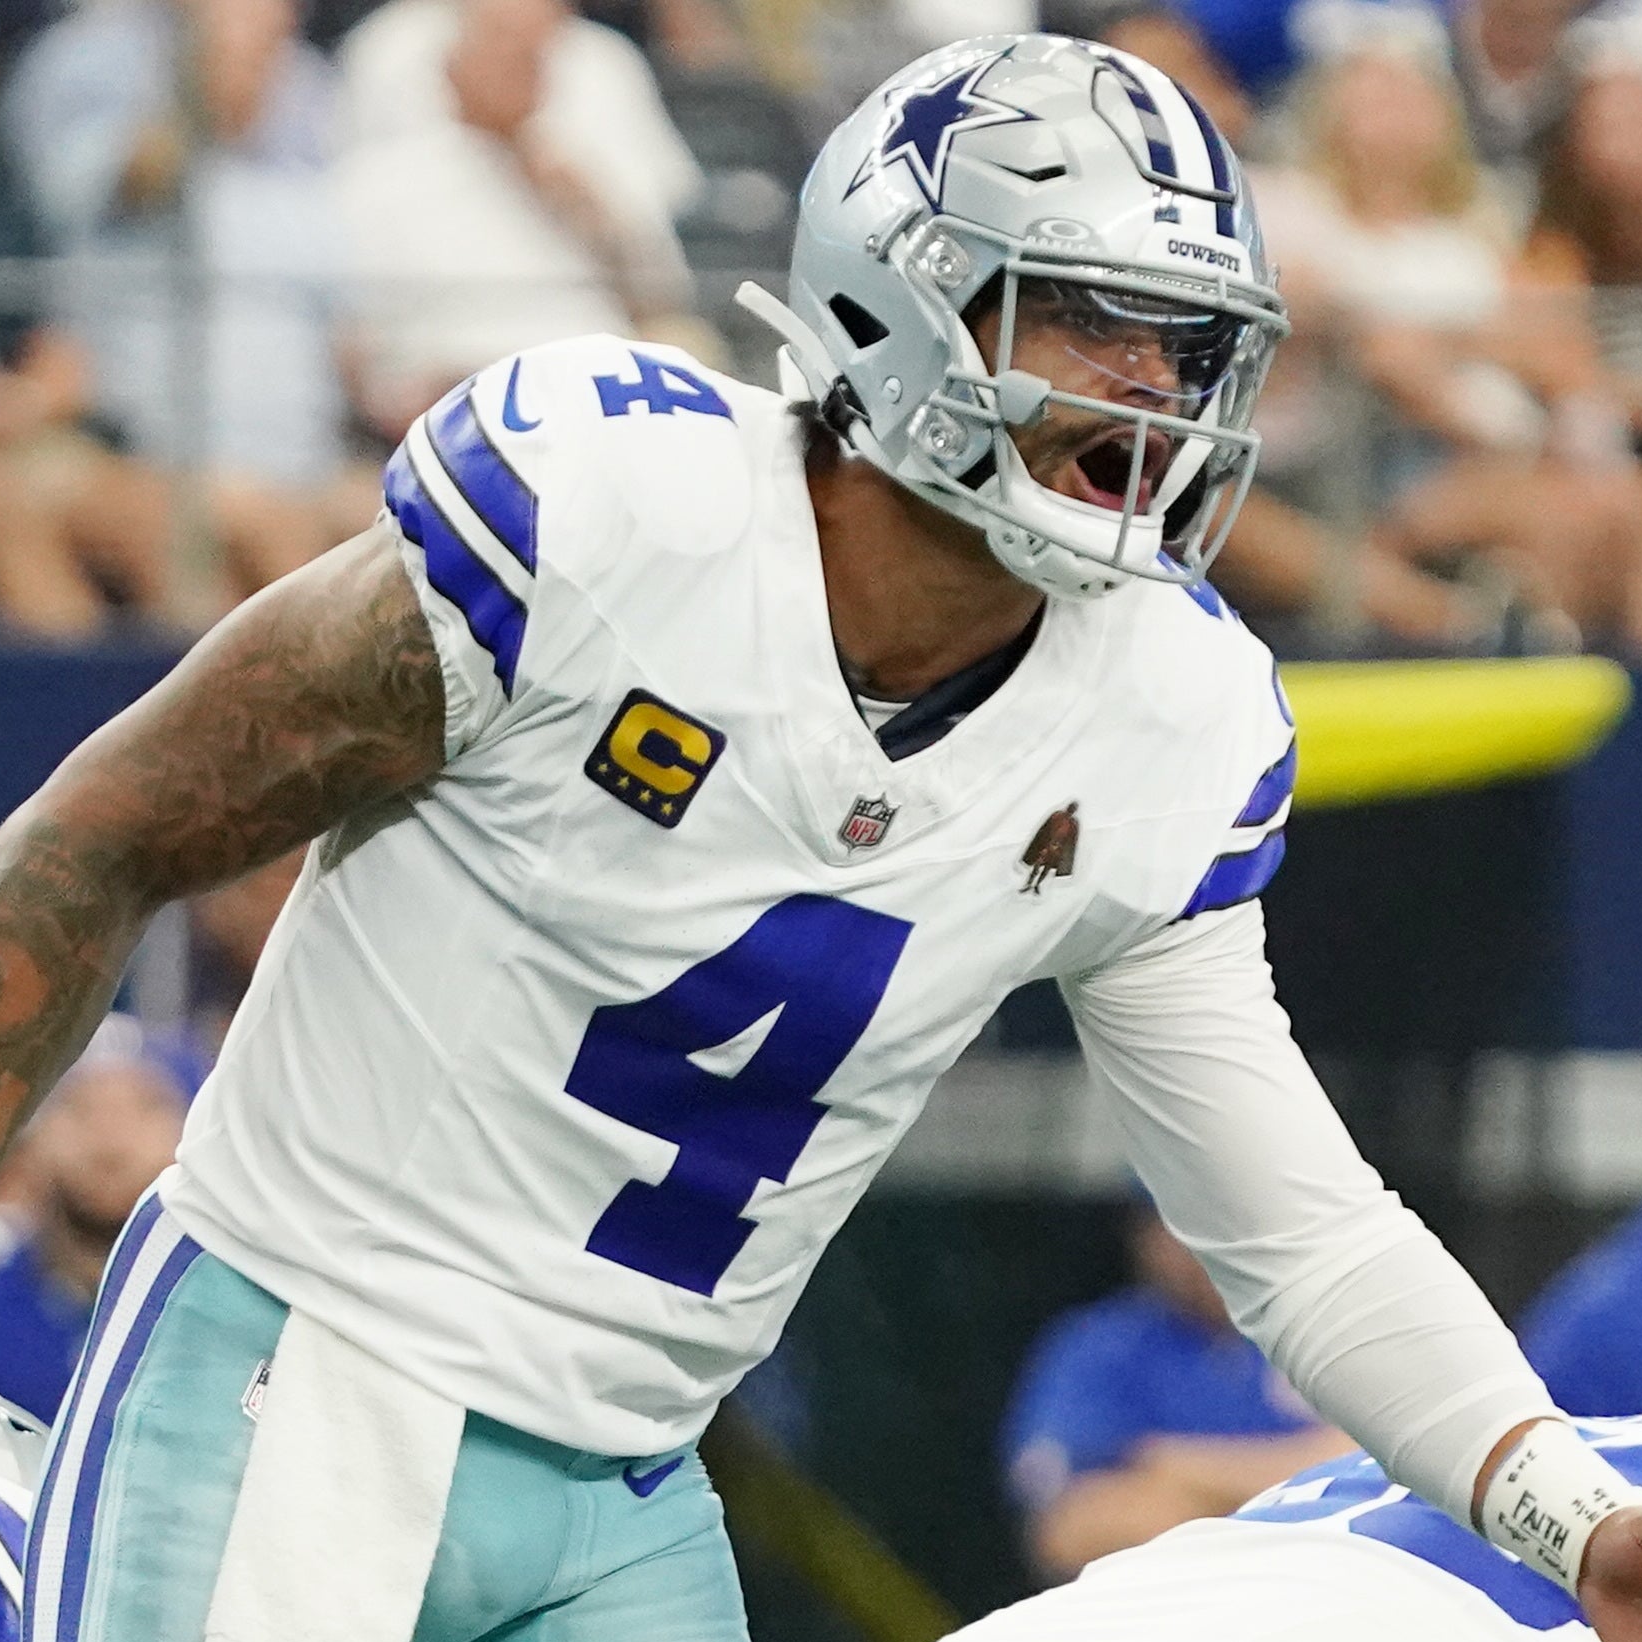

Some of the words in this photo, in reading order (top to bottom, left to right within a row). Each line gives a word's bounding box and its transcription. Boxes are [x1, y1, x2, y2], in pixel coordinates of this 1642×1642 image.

[1167, 238, 1241, 274] COWBOYS
[593, 349, 739, 420] 4
[607, 702, 713, 797] C
[845, 818, 880, 843] NFL
[562, 892, 917, 1299] 4
[1512, 1489, 1570, 1551] FAITH
